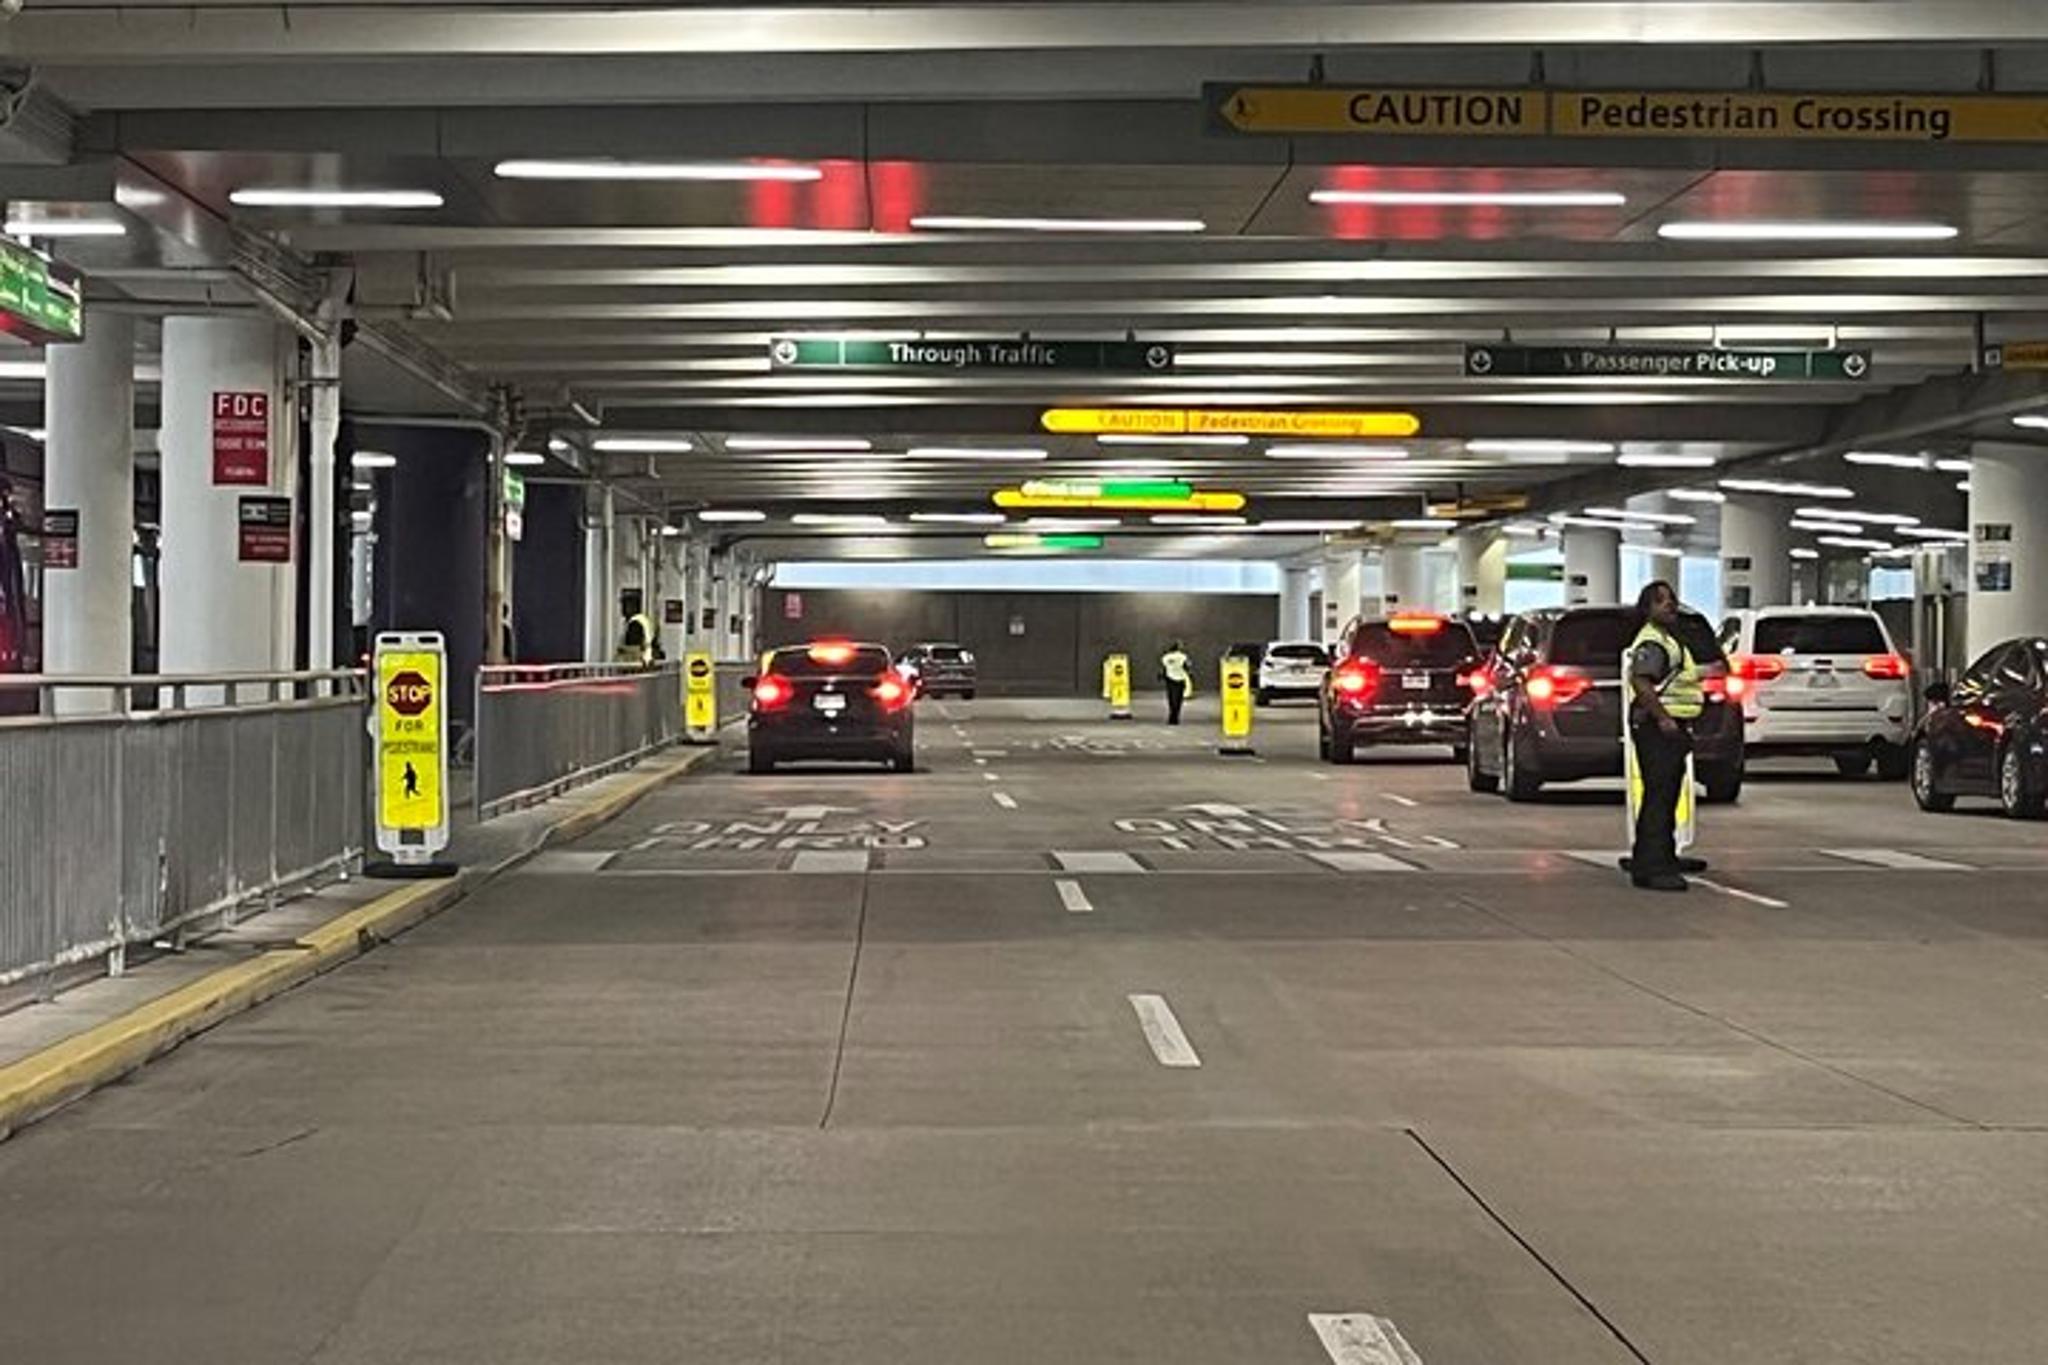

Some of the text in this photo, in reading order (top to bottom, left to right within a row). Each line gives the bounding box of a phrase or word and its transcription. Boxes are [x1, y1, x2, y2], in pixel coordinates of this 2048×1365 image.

[1350, 94, 1951, 139] CAUTION Pedestrian Crossing
[889, 343, 1056, 368] Through Traffic
[1582, 352, 1777, 377] Passenger Pick-up
[217, 394, 264, 417] FDC
[1098, 410, 1176, 428] CAUTION
[1200, 413, 1287, 430] Pedestrian
[388, 685, 431, 703] STOP
[395, 719, 425, 732] FOR
[651, 819, 929, 834] ONLY
[1112, 817, 1390, 833] ONLY
